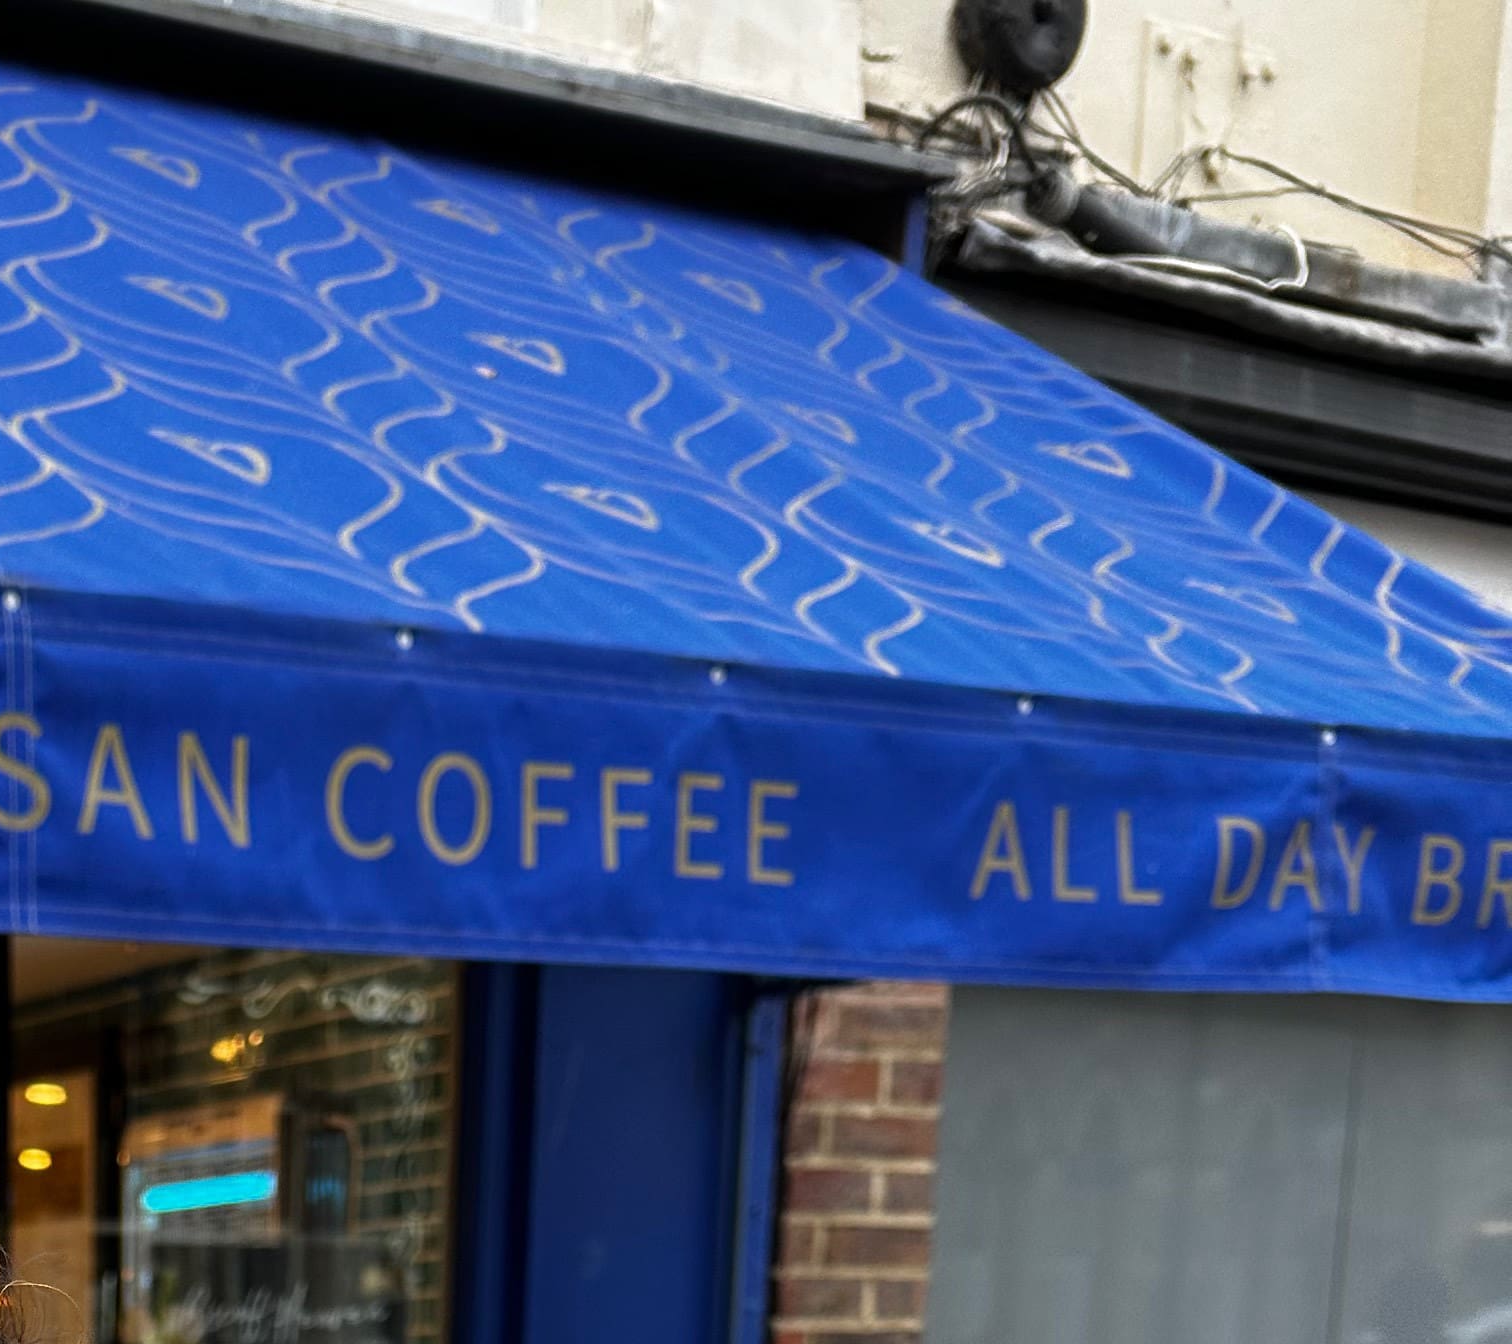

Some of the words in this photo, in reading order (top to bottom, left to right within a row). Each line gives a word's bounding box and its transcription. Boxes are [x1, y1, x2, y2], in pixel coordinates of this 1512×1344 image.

[324, 744, 799, 886] COFFEE
[969, 800, 1164, 907] ALL
[1210, 814, 1377, 915] DAY
